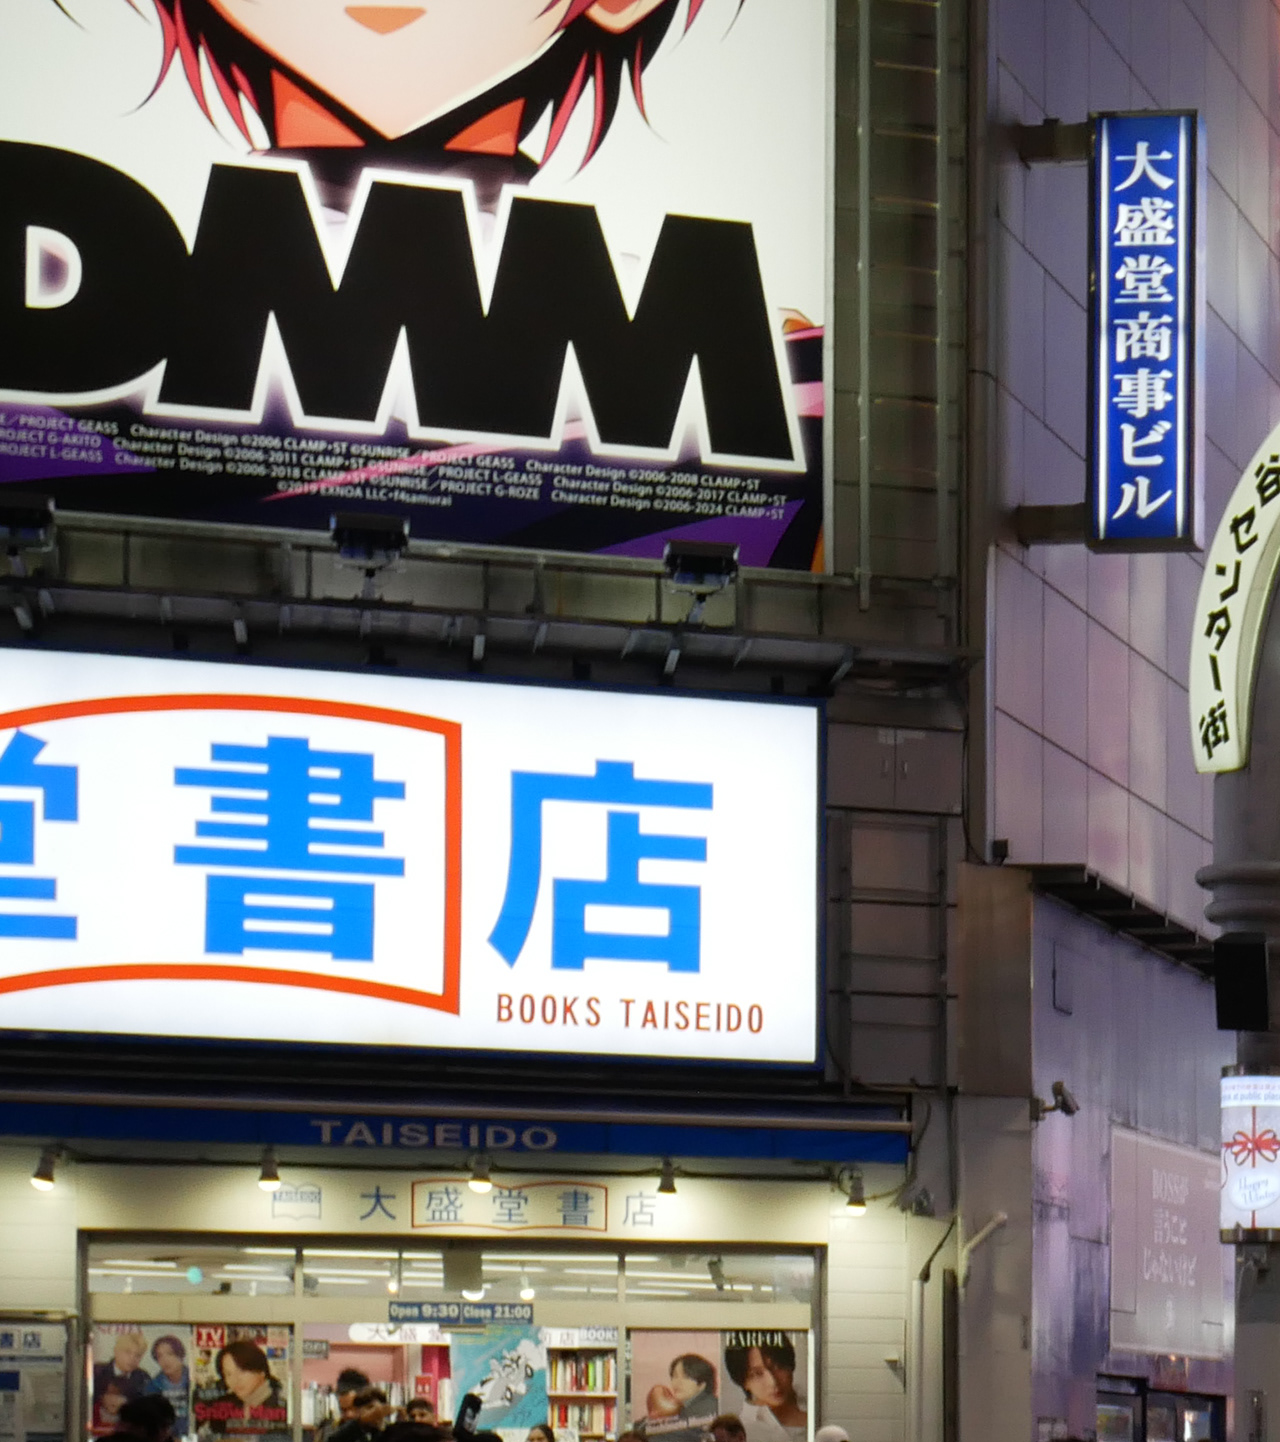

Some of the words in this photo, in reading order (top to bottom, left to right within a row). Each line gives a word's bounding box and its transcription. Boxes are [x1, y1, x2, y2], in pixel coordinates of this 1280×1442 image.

[0, 141, 797, 463] DMM
[1114, 141, 1175, 521] 大盛堂商事ビル
[112, 436, 174, 456] Character
[176, 442, 222, 461] Design
[552, 474, 611, 493] Character
[612, 481, 653, 497] Design
[130, 423, 193, 443] Character
[195, 429, 240, 447] Design
[525, 459, 584, 476] Character
[586, 464, 627, 480] Design
[114, 452, 177, 470] Character
[179, 457, 223, 474] Design
[550, 489, 609, 506] Character
[610, 494, 652, 511] Design
[496, 993, 602, 1028] BOOKS
[622, 998, 765, 1034] TAISEIDO
[310, 1119, 559, 1150] TAISEIDO
[359, 1185, 658, 1227] 大盛堂書店
[390, 1304, 419, 1321] Open
[421, 1303, 460, 1318] 9:30
[494, 1304, 532, 1319] 21:00
